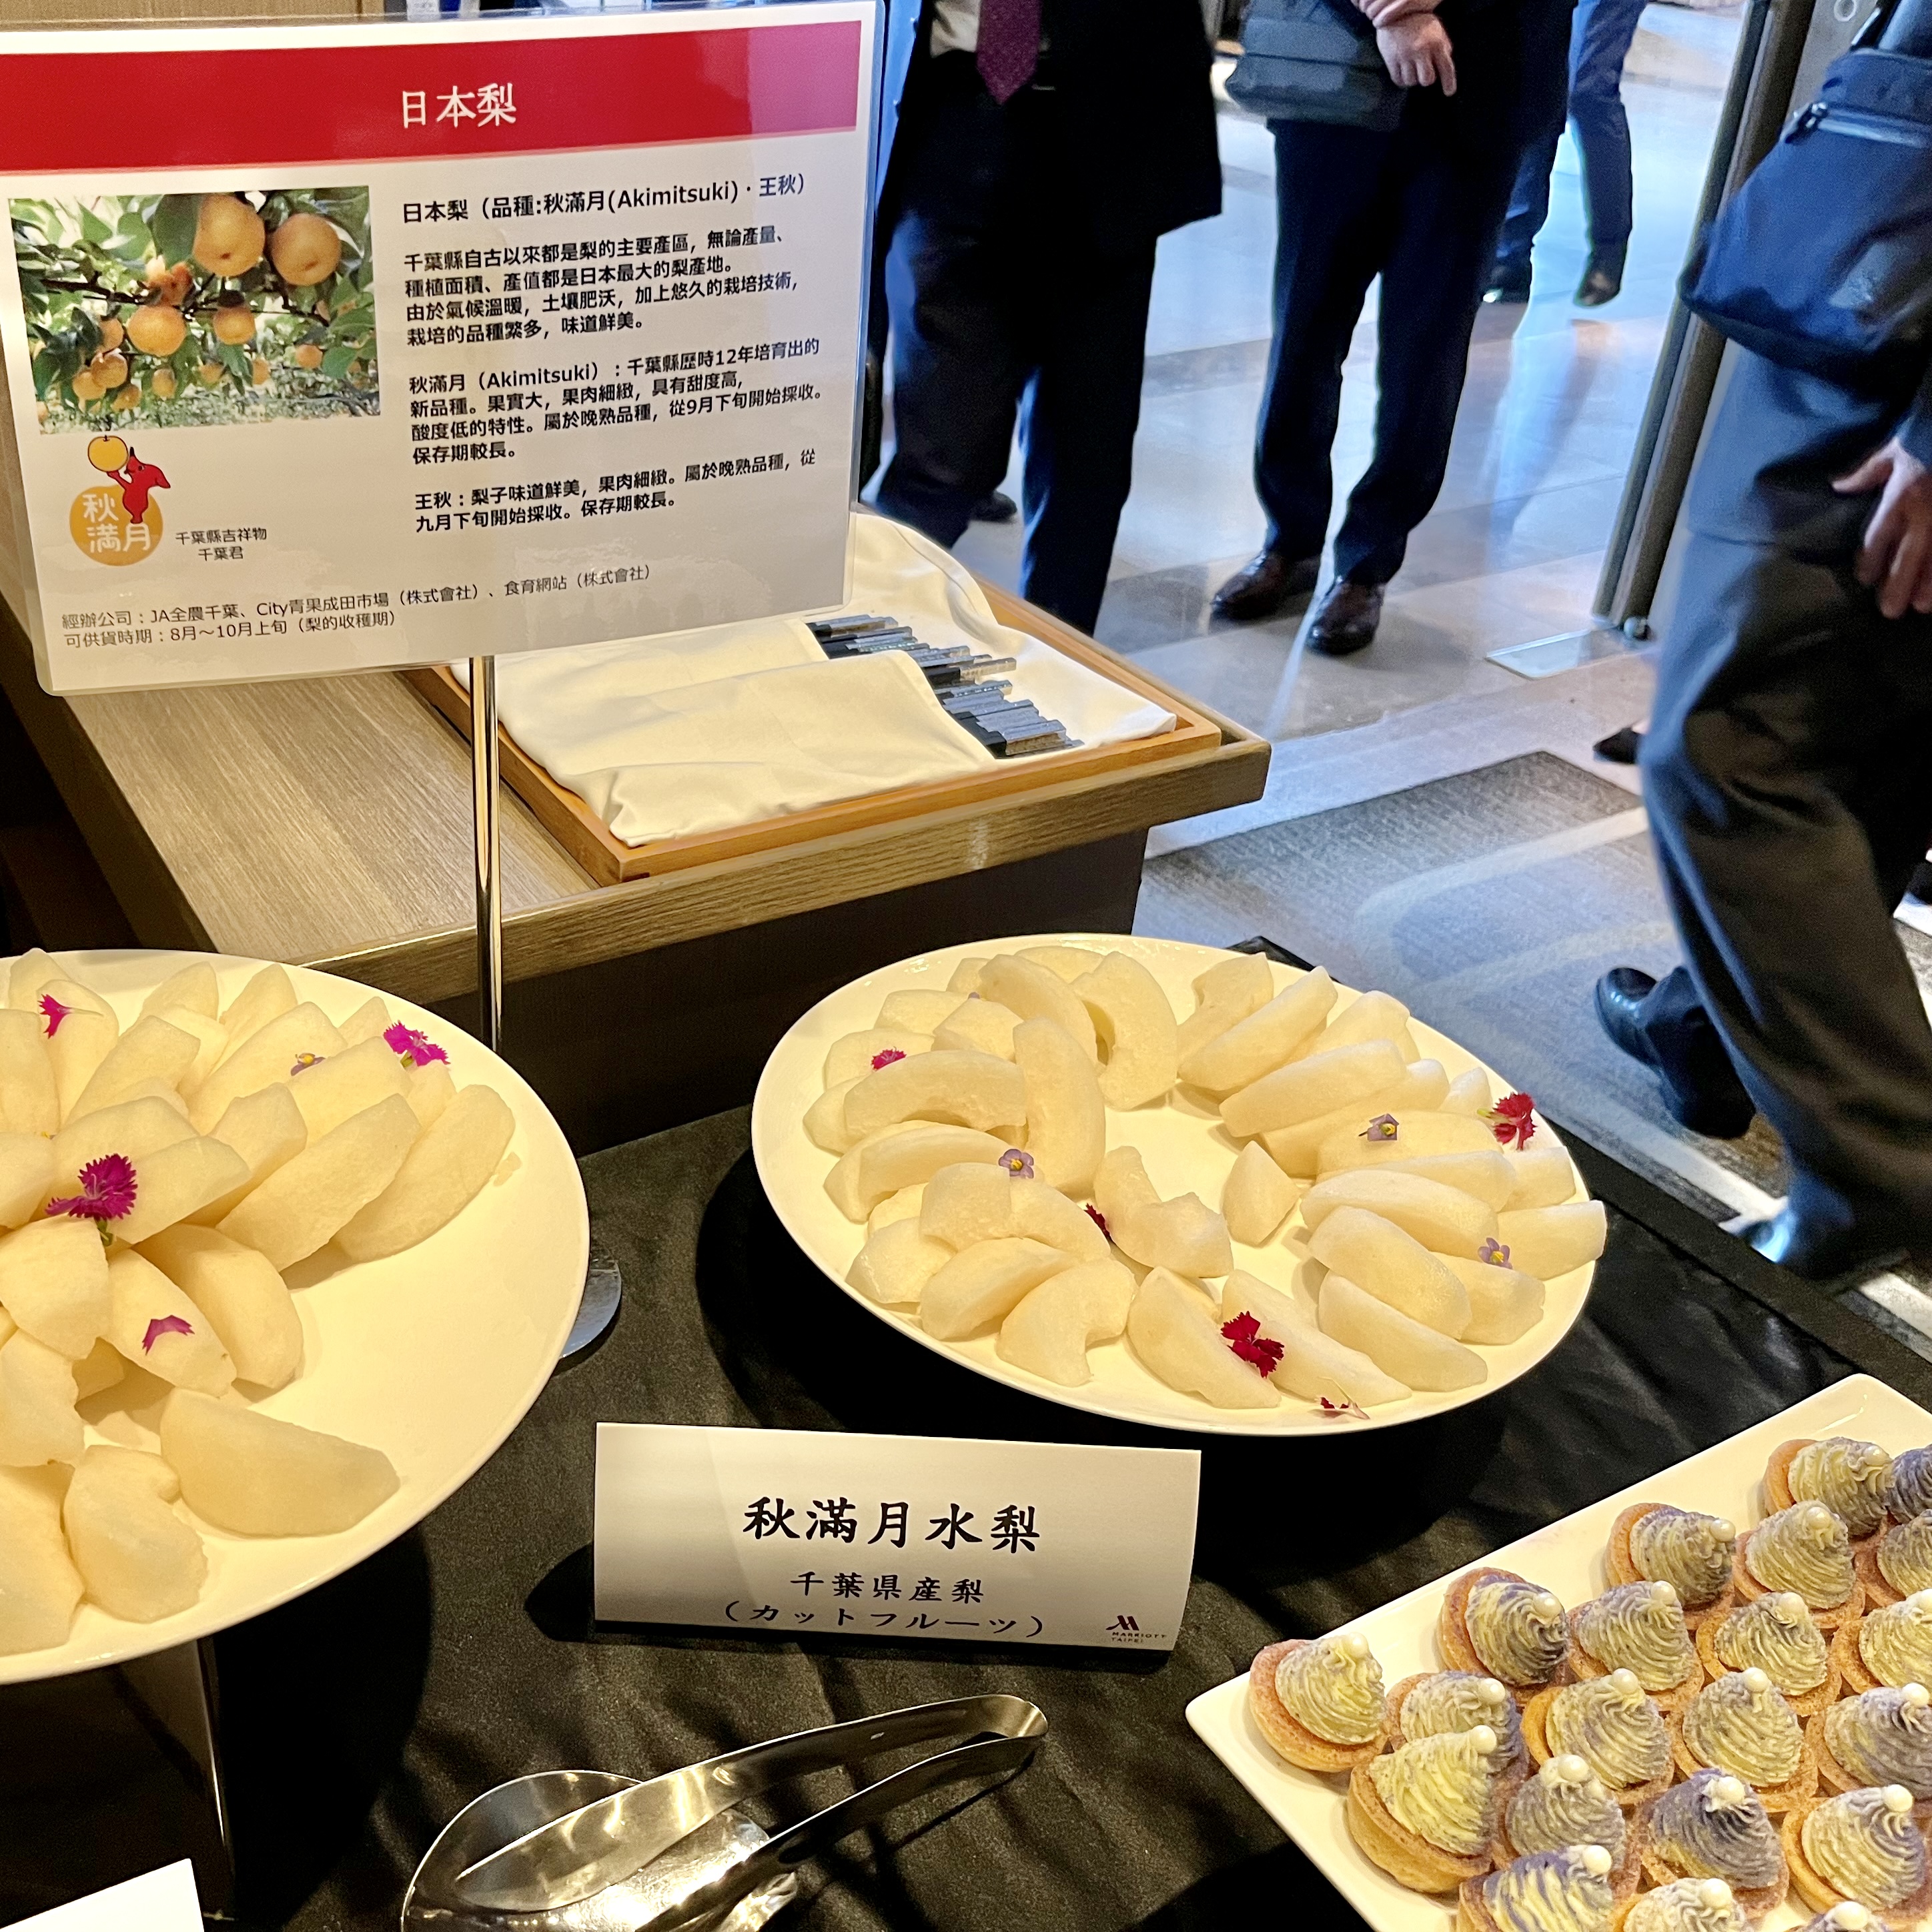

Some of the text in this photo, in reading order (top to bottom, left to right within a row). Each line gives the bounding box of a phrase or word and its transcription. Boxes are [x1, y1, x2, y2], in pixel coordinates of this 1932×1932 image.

[402, 83, 517, 129] 日本梨
[412, 441, 515, 465] 保存期較長。
[416, 490, 675, 533] 九月下旬開始採收。保存期較長。
[175, 527, 268, 546] 千葉縣吉祥物
[198, 546, 244, 561] 千葉君
[742, 1495, 1041, 1555] 秋滿月水梨
[790, 1570, 985, 1605] 千葉県産梨
[725, 1600, 1044, 1638] （カットフルーツ）
